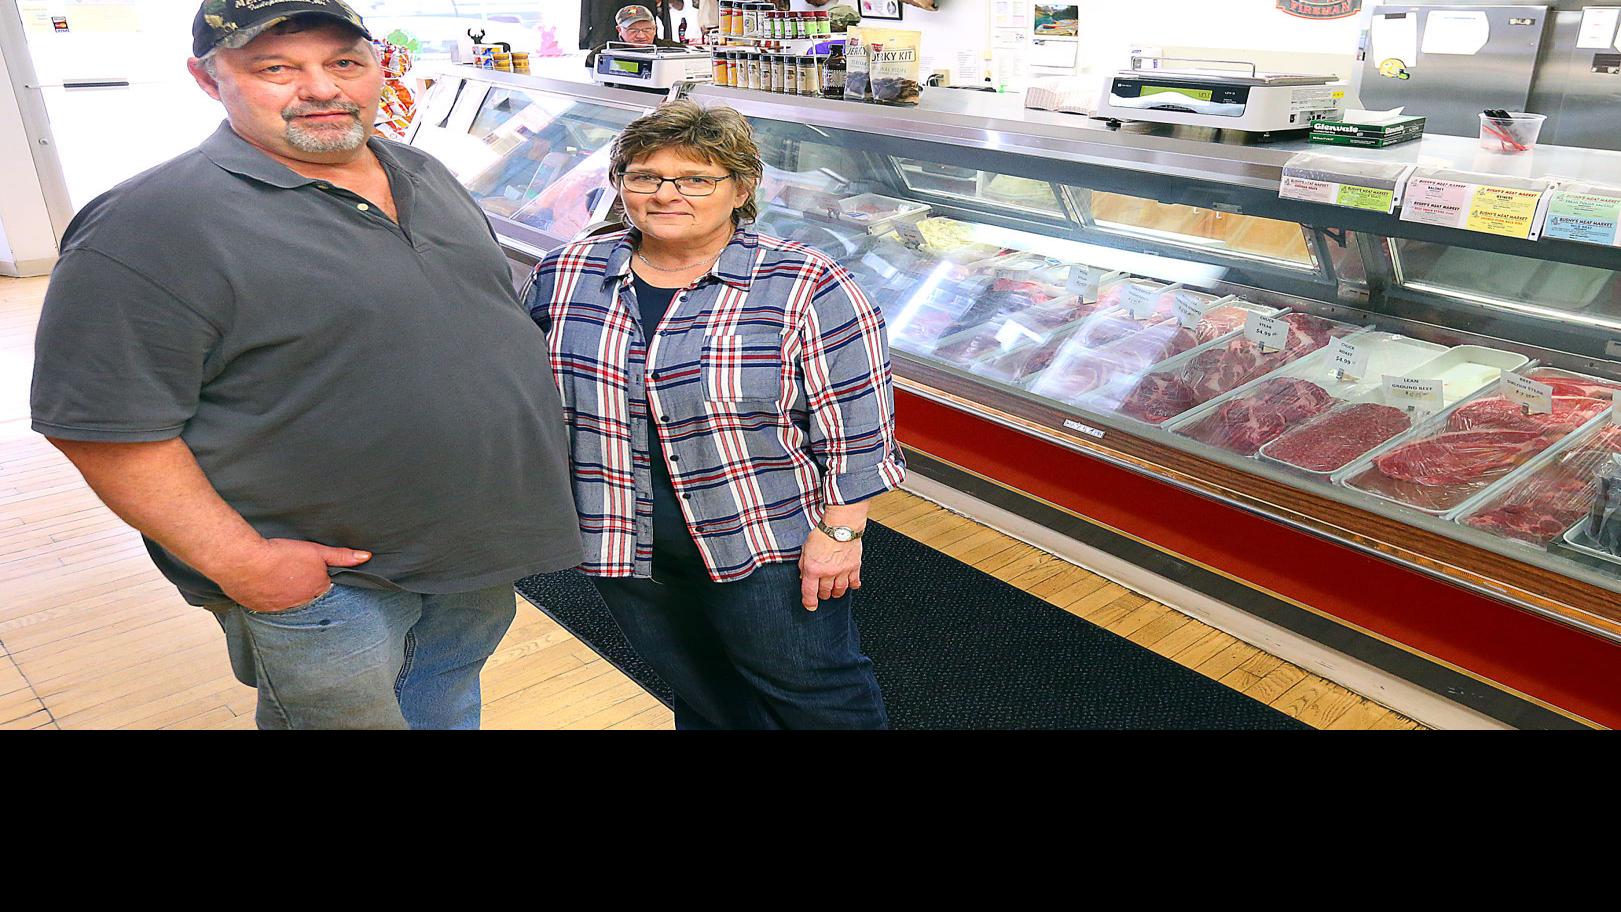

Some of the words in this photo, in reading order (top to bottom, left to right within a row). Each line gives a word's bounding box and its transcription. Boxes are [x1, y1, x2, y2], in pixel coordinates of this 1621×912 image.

[1290, 1, 1351, 15] FIREMAN
[899, 51, 913, 61] KIT
[1313, 122, 1359, 133] Glenvale
[1391, 383, 1417, 391] GROUND
